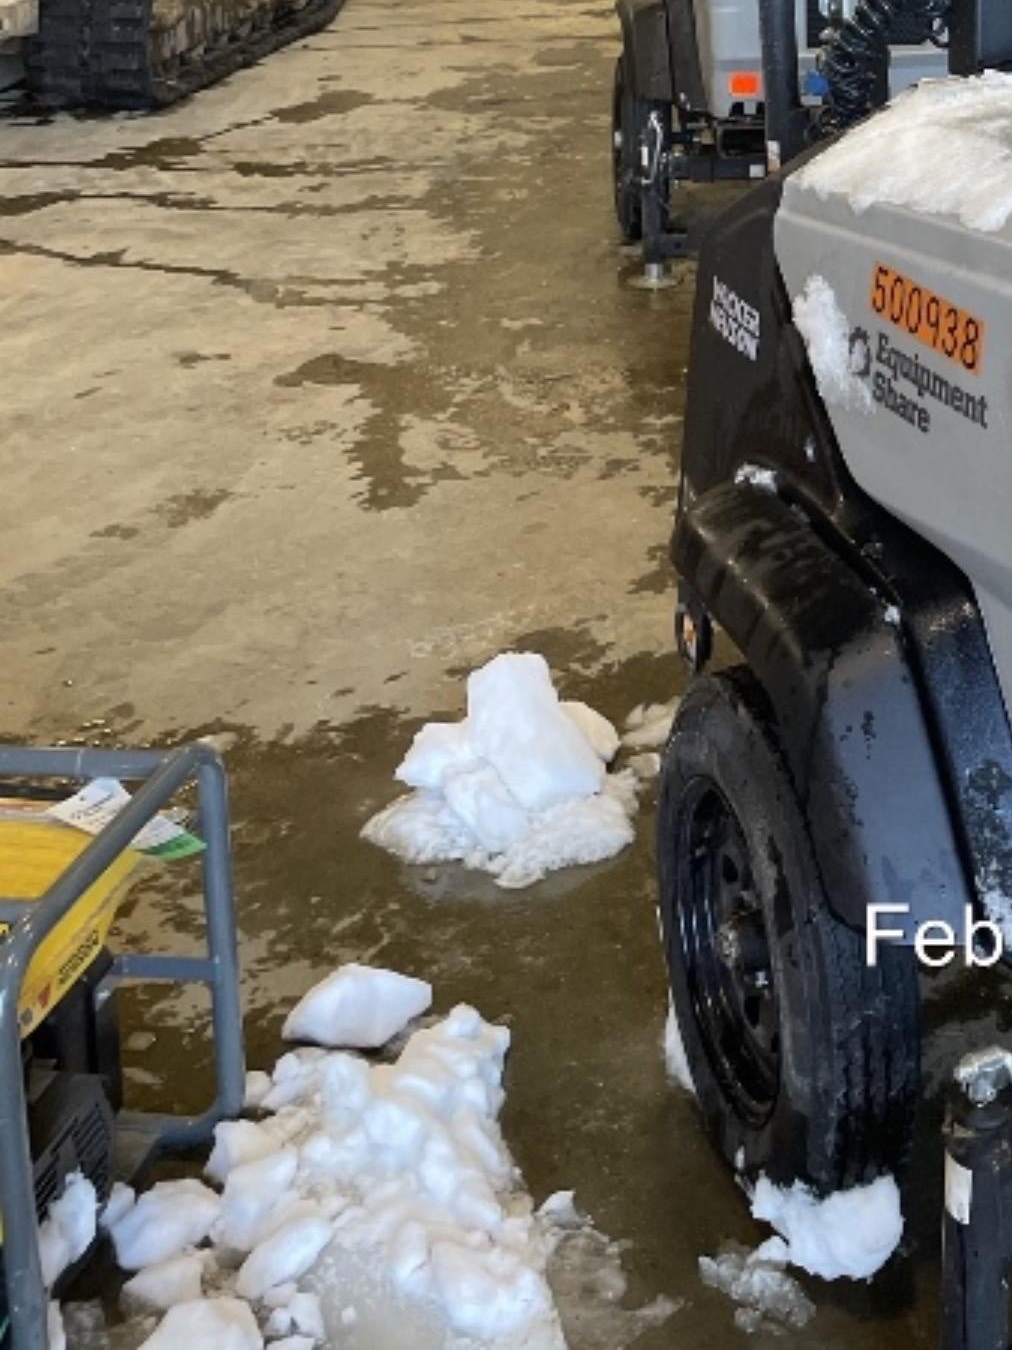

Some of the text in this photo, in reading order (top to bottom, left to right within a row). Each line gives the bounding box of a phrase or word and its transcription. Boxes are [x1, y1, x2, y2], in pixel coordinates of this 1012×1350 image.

[872, 266, 979, 370] 500938
[872, 370, 931, 433] Share
[875, 332, 988, 430] Equipment
